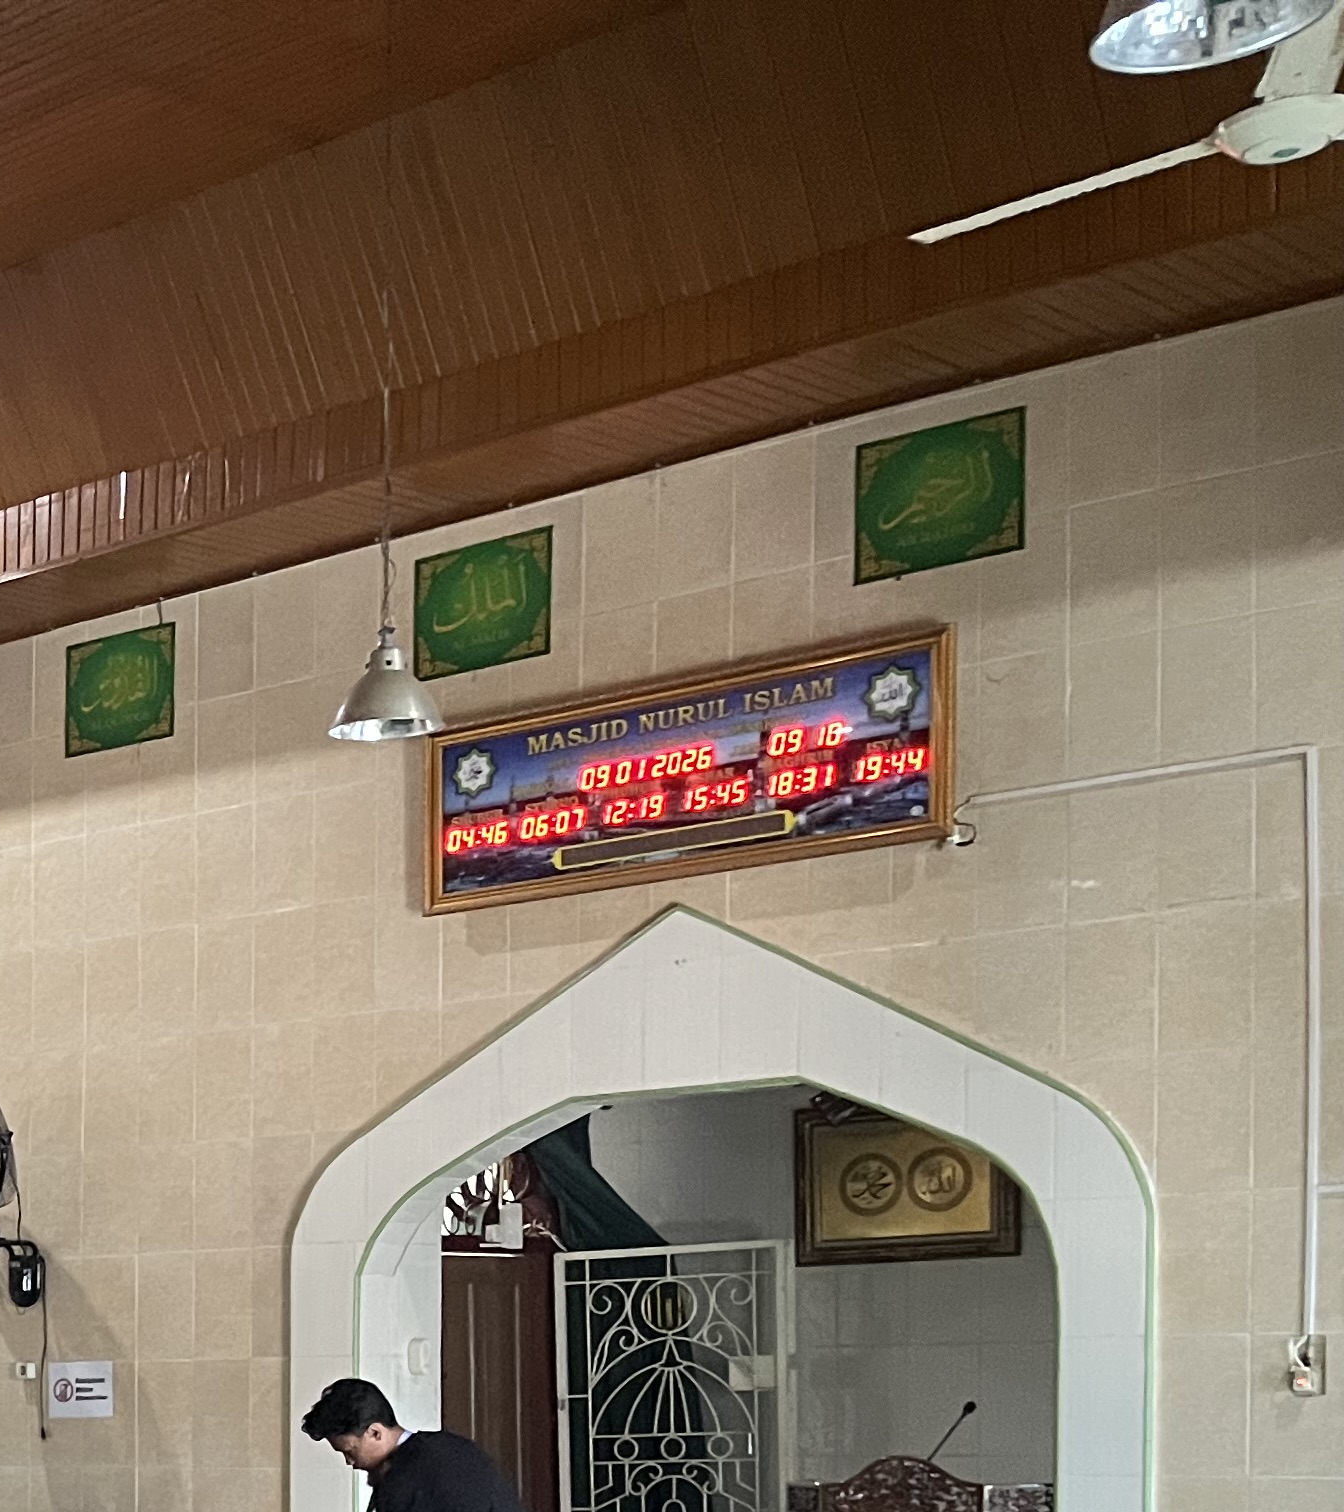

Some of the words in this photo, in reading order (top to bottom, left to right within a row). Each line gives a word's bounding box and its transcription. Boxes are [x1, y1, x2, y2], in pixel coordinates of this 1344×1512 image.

[526, 718, 628, 756] MASJID
[638, 698, 731, 735] NURUL
[743, 677, 836, 712] ISLAM
[768, 765, 835, 796] 18:31
[857, 748, 925, 781] 19:44
[604, 795, 664, 825] 12:19
[685, 780, 746, 811] 15:45
[446, 821, 508, 853] 04:46
[520, 808, 587, 840] 06:07
